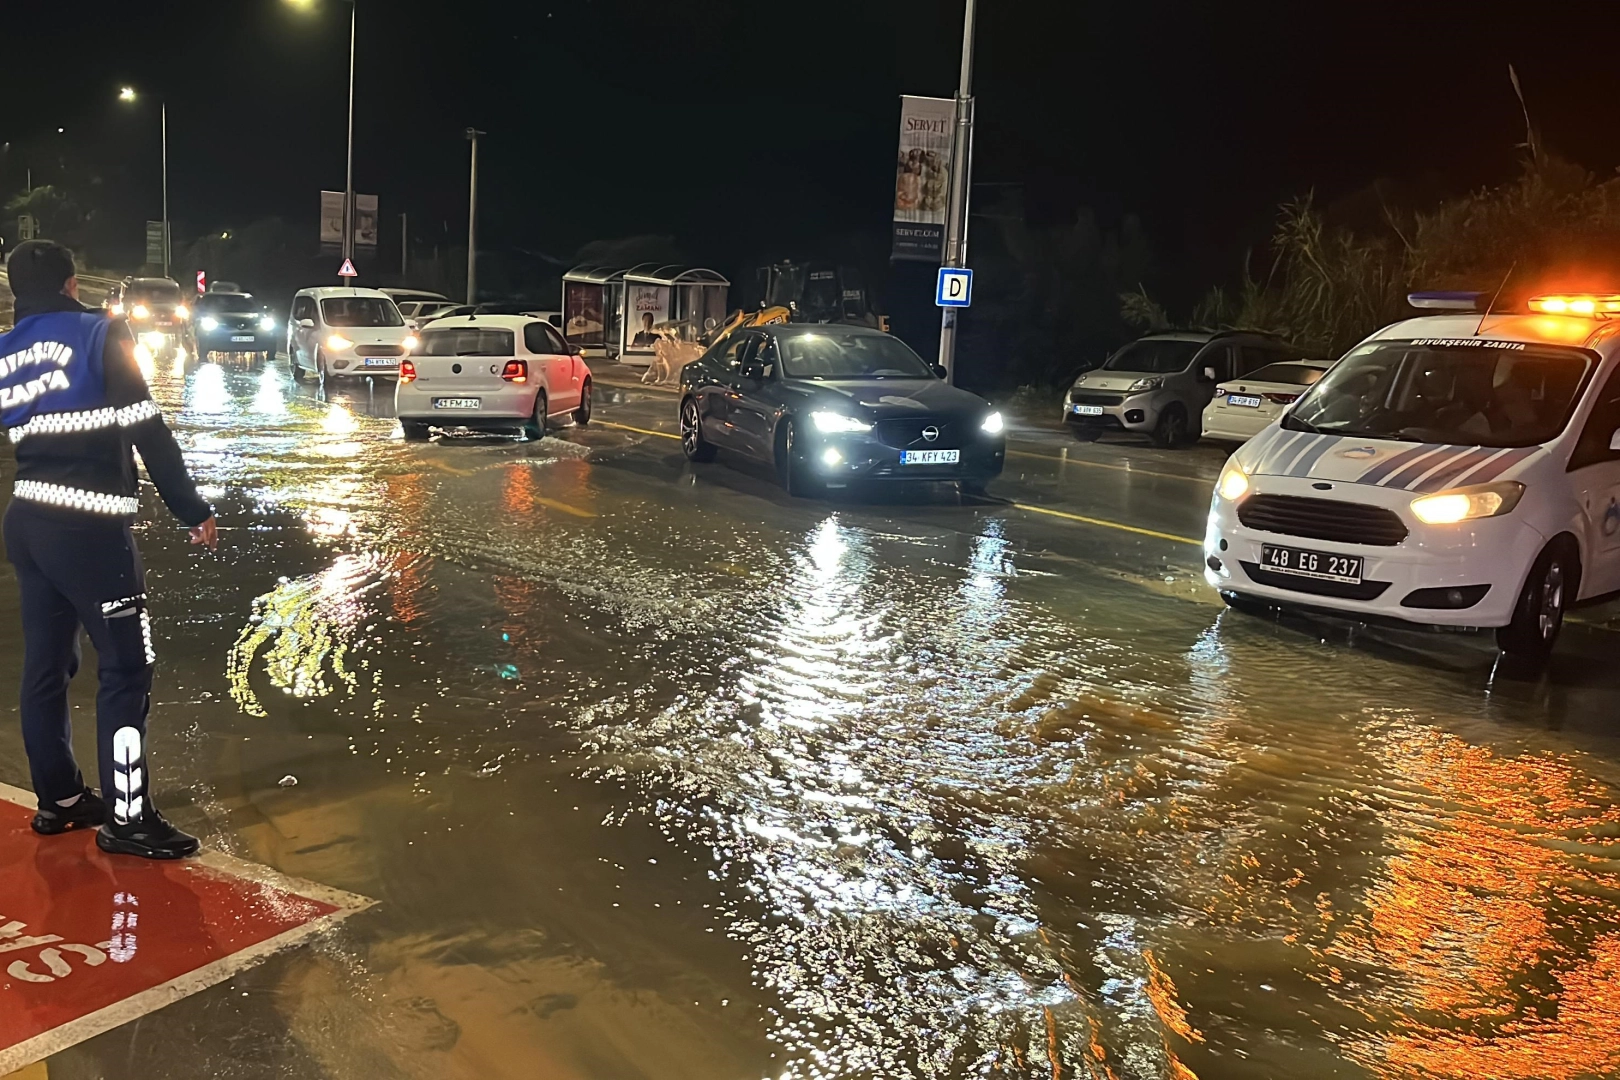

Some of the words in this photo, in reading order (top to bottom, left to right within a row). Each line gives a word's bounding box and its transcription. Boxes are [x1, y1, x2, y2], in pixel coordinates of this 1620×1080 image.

[906, 117, 947, 134] SERVET
[949, 278, 961, 297] D
[1410, 337, 1482, 347] BÜYÜKŞEHİR
[1483, 340, 1526, 351] ZABITA
[906, 452, 917, 462] 34
[921, 451, 938, 462] KFY
[940, 451, 957, 462] 423
[1270, 548, 1289, 567] 48
[1298, 552, 1318, 571] EG
[1328, 557, 1358, 576] 237
